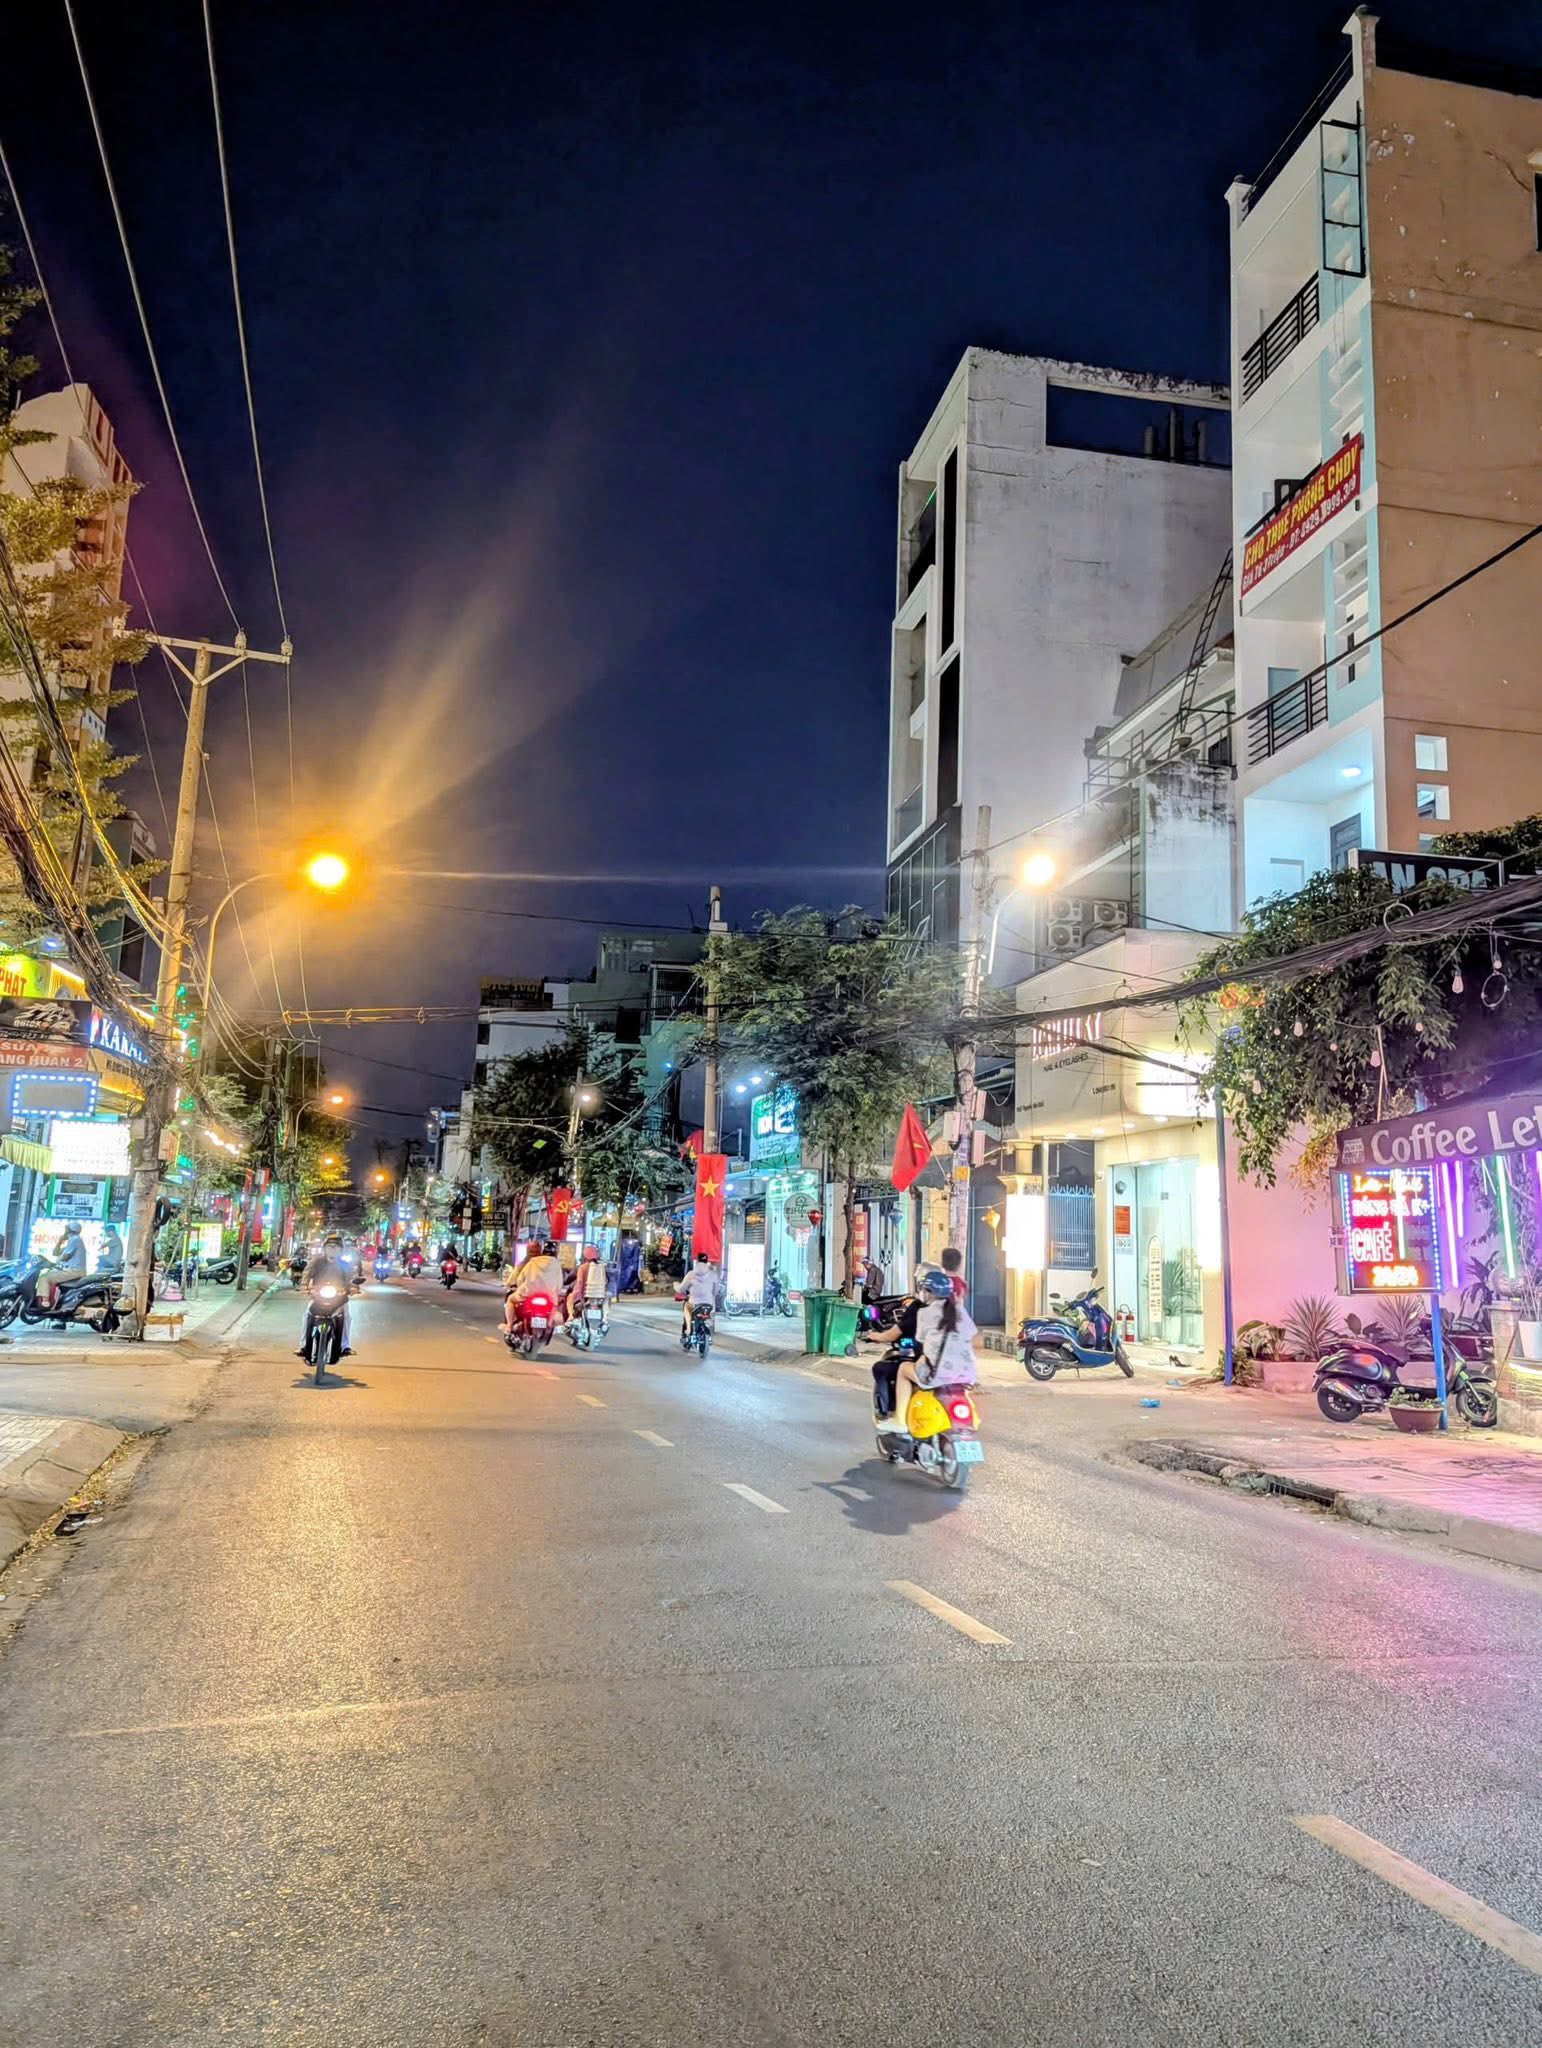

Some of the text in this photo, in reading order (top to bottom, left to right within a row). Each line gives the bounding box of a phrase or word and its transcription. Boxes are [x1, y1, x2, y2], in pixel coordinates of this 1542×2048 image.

[1245, 538, 1264, 569] CHO
[1370, 1121, 1478, 1166] Coffee
[1352, 1221, 1394, 1262] CAFÉ
